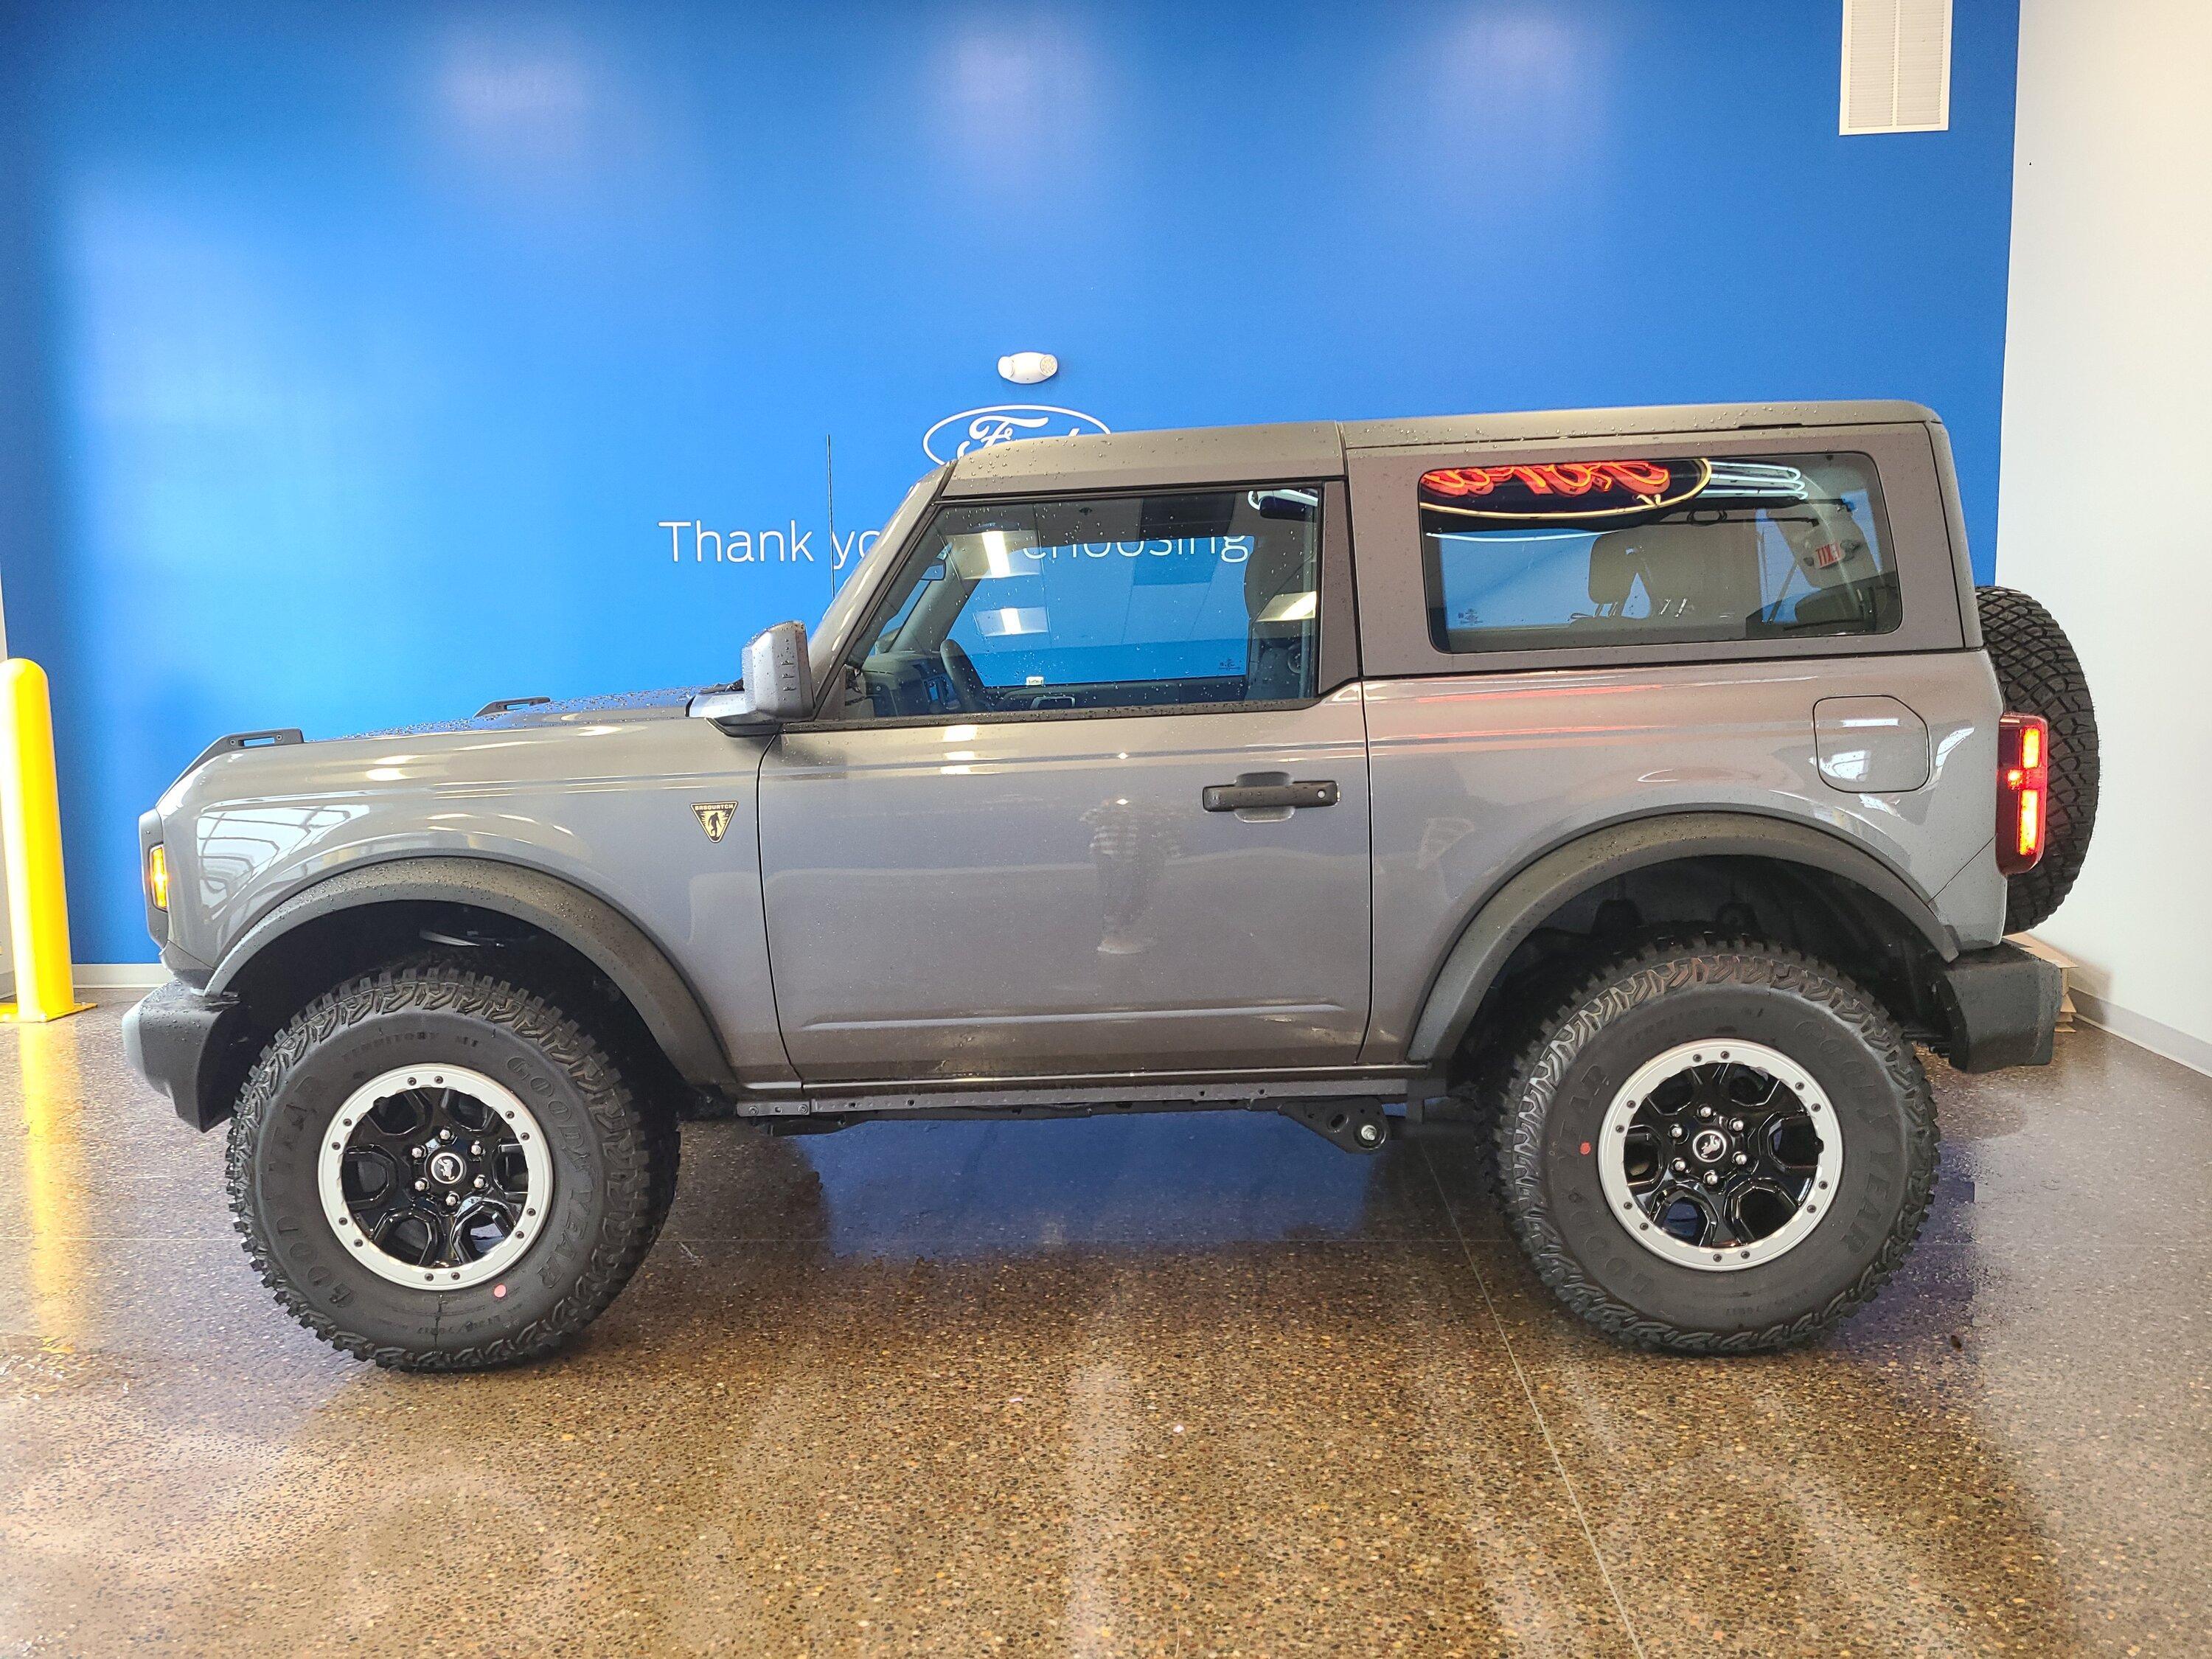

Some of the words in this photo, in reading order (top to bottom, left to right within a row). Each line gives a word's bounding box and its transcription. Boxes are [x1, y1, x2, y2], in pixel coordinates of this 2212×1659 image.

[657, 519, 814, 563] Thank
[832, 530, 880, 570] yo
[505, 1054, 594, 1290] GOODYEAR
